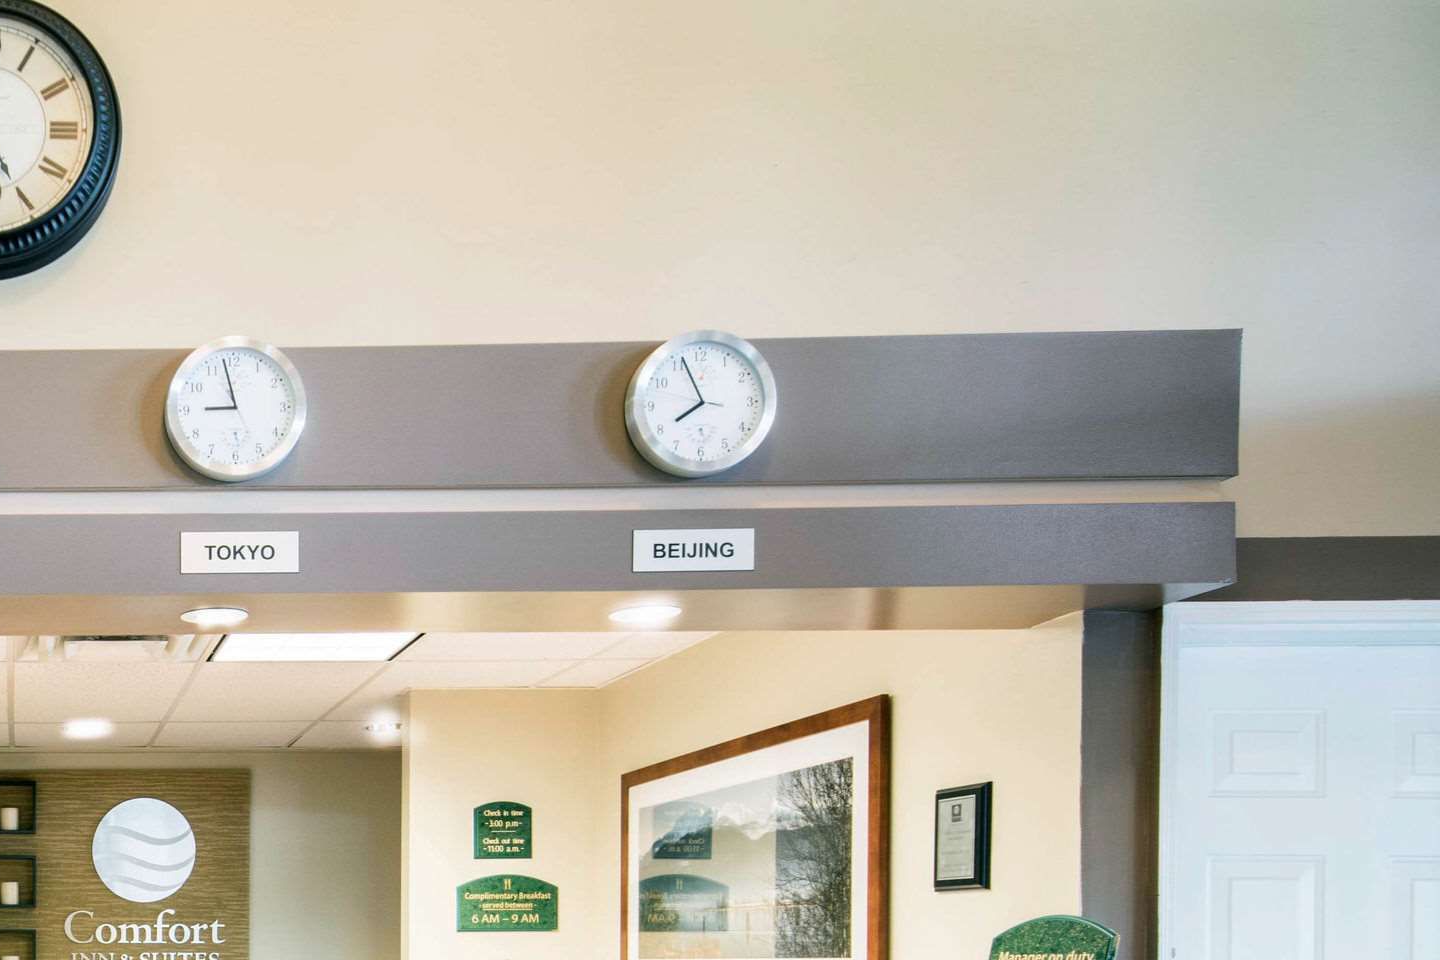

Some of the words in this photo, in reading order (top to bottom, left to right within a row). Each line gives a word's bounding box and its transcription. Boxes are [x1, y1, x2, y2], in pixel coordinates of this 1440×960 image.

[694, 351, 707, 362] 12
[227, 357, 241, 368] 12
[206, 366, 218, 376] 11
[655, 378, 669, 388] 10
[738, 372, 745, 383] 2
[189, 383, 204, 393] 10
[271, 378, 278, 389] 2
[280, 402, 287, 413] 3
[647, 401, 655, 412] 9
[747, 397, 754, 408] 3
[182, 406, 190, 416] 9
[192, 428, 200, 439] 8
[657, 425, 664, 435] 8
[255, 443, 263, 454] 5
[721, 438, 729, 450] 5
[232, 451, 239, 461] 6
[697, 447, 705, 458] 6
[204, 545, 275, 561] TOKYO
[653, 542, 735, 559] BEIJING
[483, 809, 501, 817] Check
[503, 809, 509, 817] in
[464, 892, 517, 901] Complimentary
[518, 892, 552, 900] Breakfast
[471, 913, 479, 923] 6
[481, 914, 500, 923] AM
[511, 913, 519, 923] 9
[520, 914, 539, 923] AM
[63, 909, 227, 945] Comfort
